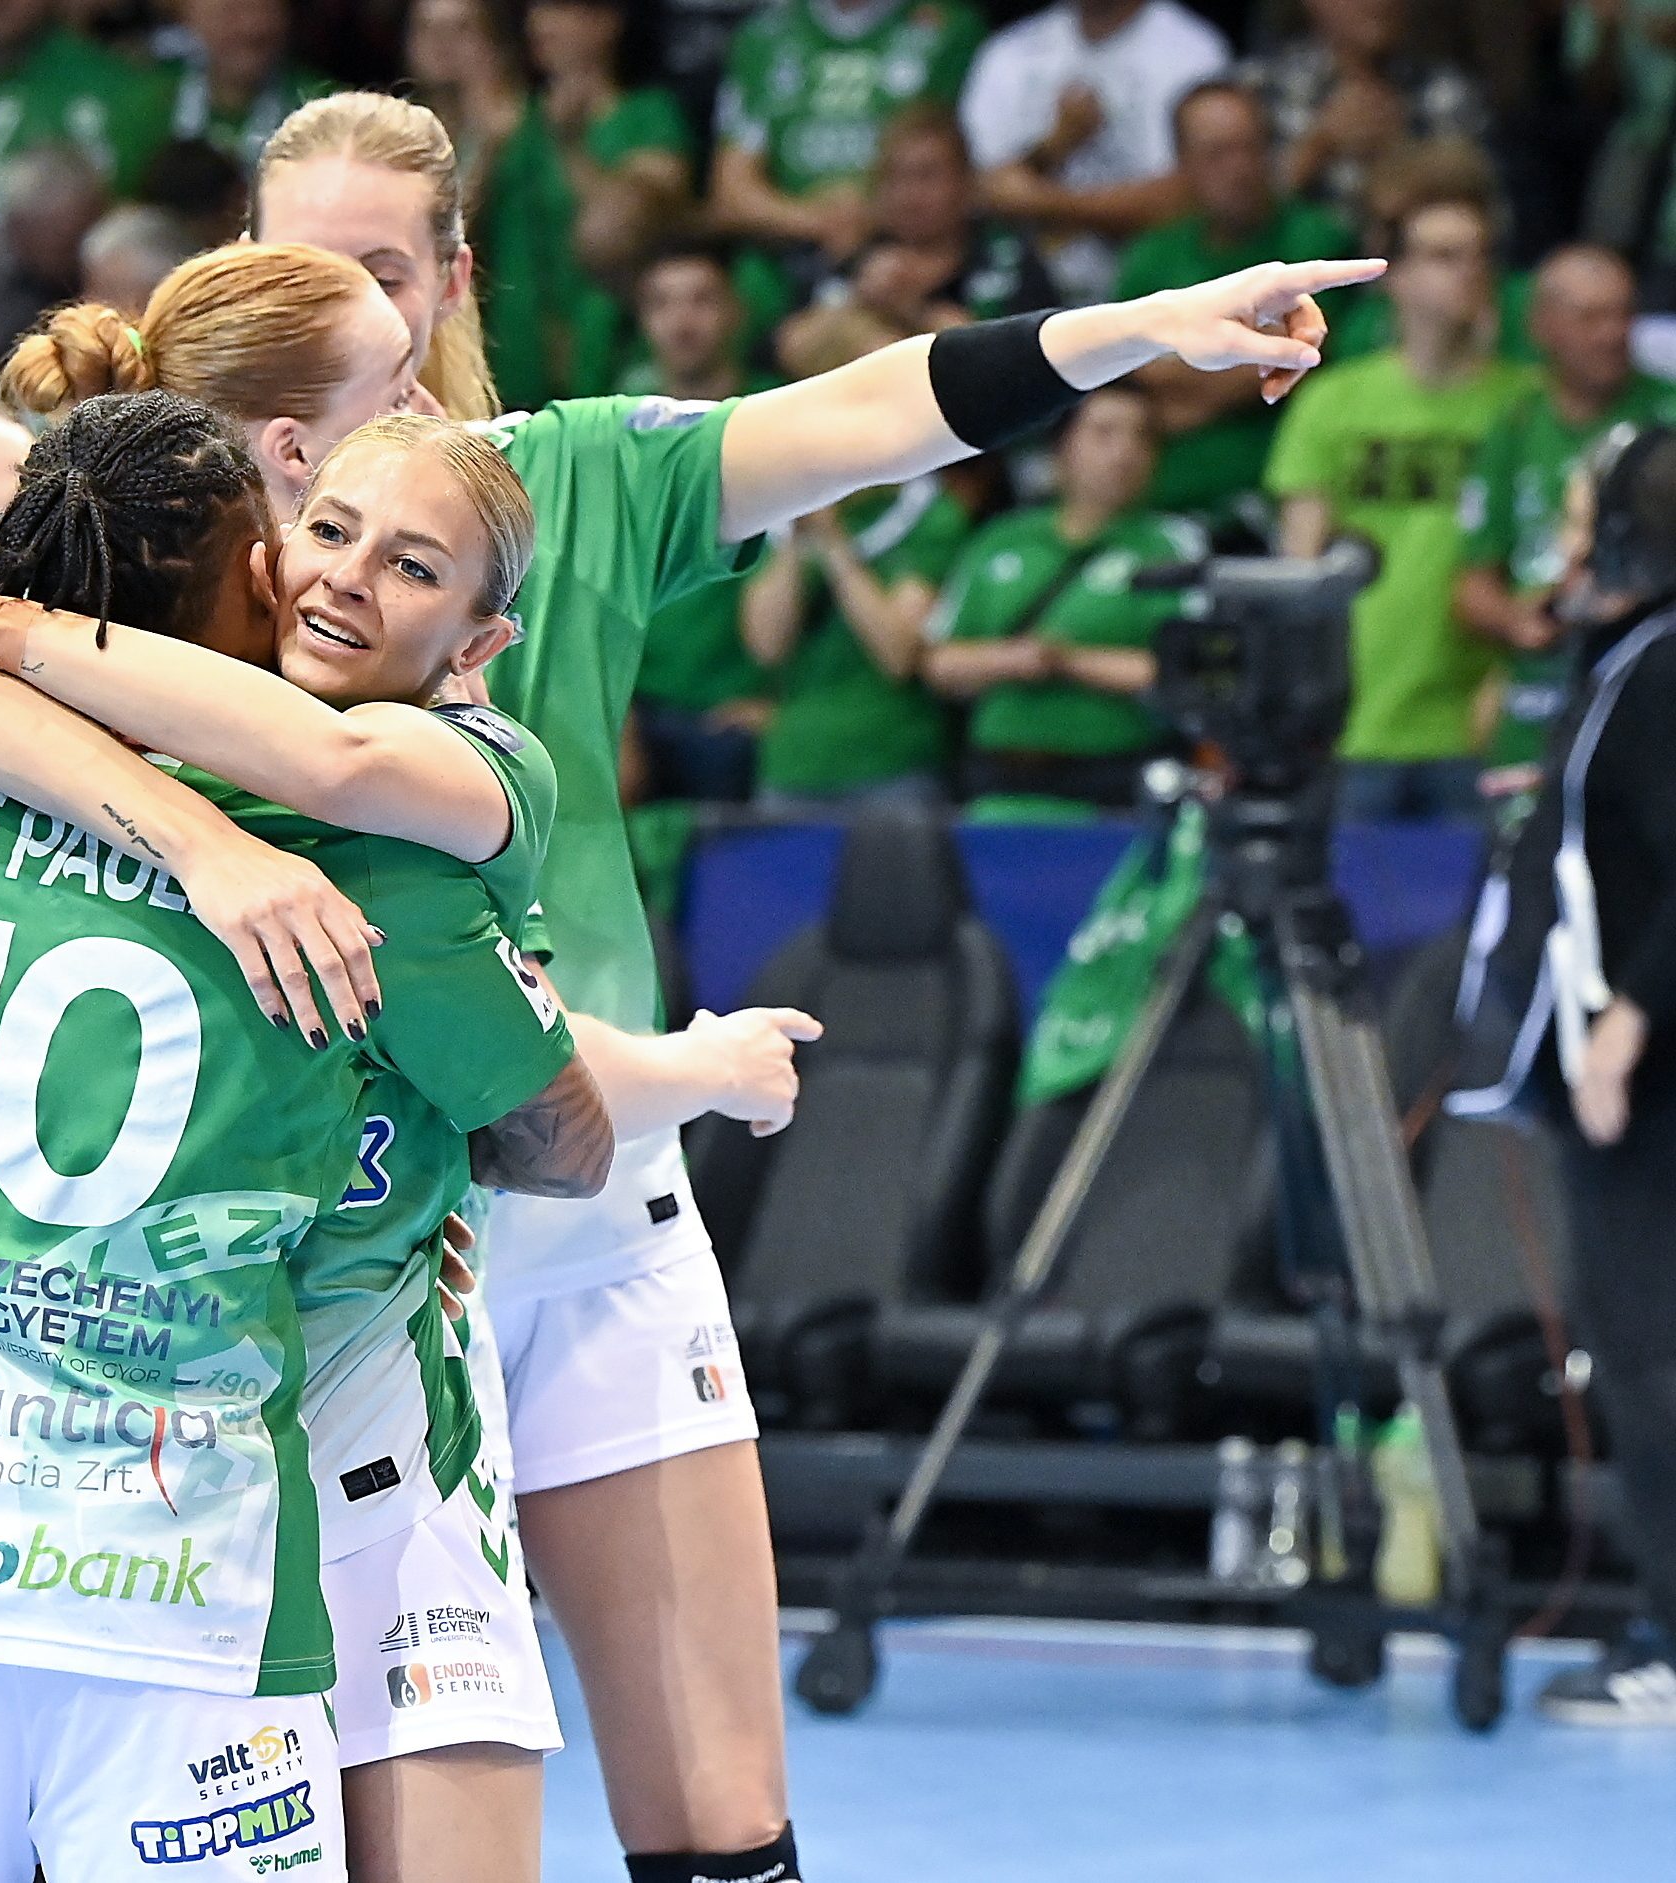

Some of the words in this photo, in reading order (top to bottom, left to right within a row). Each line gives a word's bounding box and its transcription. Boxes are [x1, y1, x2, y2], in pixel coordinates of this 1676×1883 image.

[4, 807, 195, 916] PAUL
[69, 1358, 98, 1375] OF
[75, 1460, 142, 1494] Zrt.
[433, 1662, 500, 1681] ENDOPLUS
[436, 1680, 504, 1695] SERVICE
[199, 1755, 304, 1801] SECURITY
